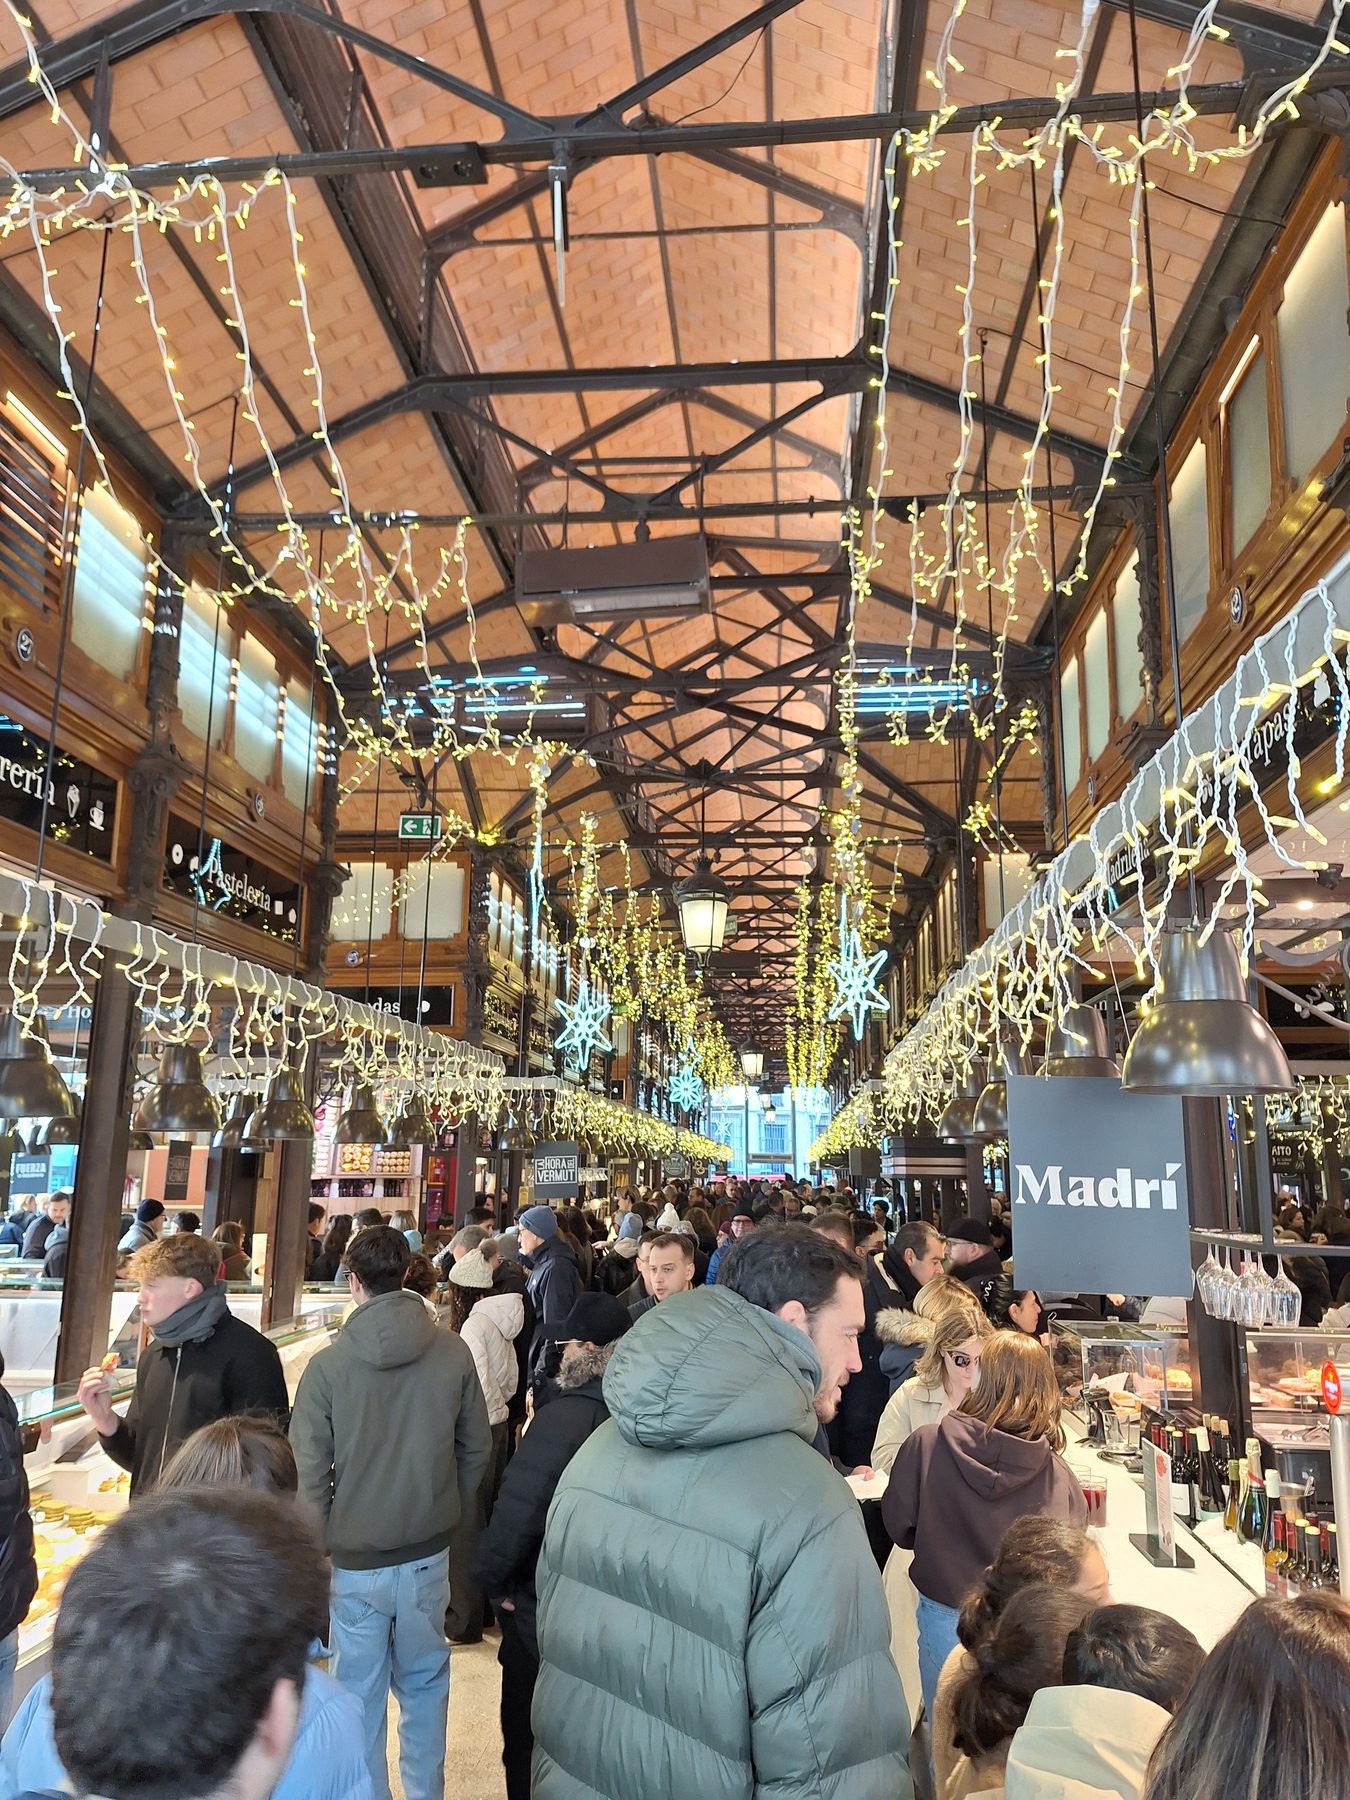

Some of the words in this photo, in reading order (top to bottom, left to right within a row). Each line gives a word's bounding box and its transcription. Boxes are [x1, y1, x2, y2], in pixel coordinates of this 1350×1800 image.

[206, 856, 271, 912] Pastelería
[537, 1170, 575, 1182] VERMUT
[545, 1158, 567, 1169] HORA
[1014, 1162, 1183, 1210] Madrí
